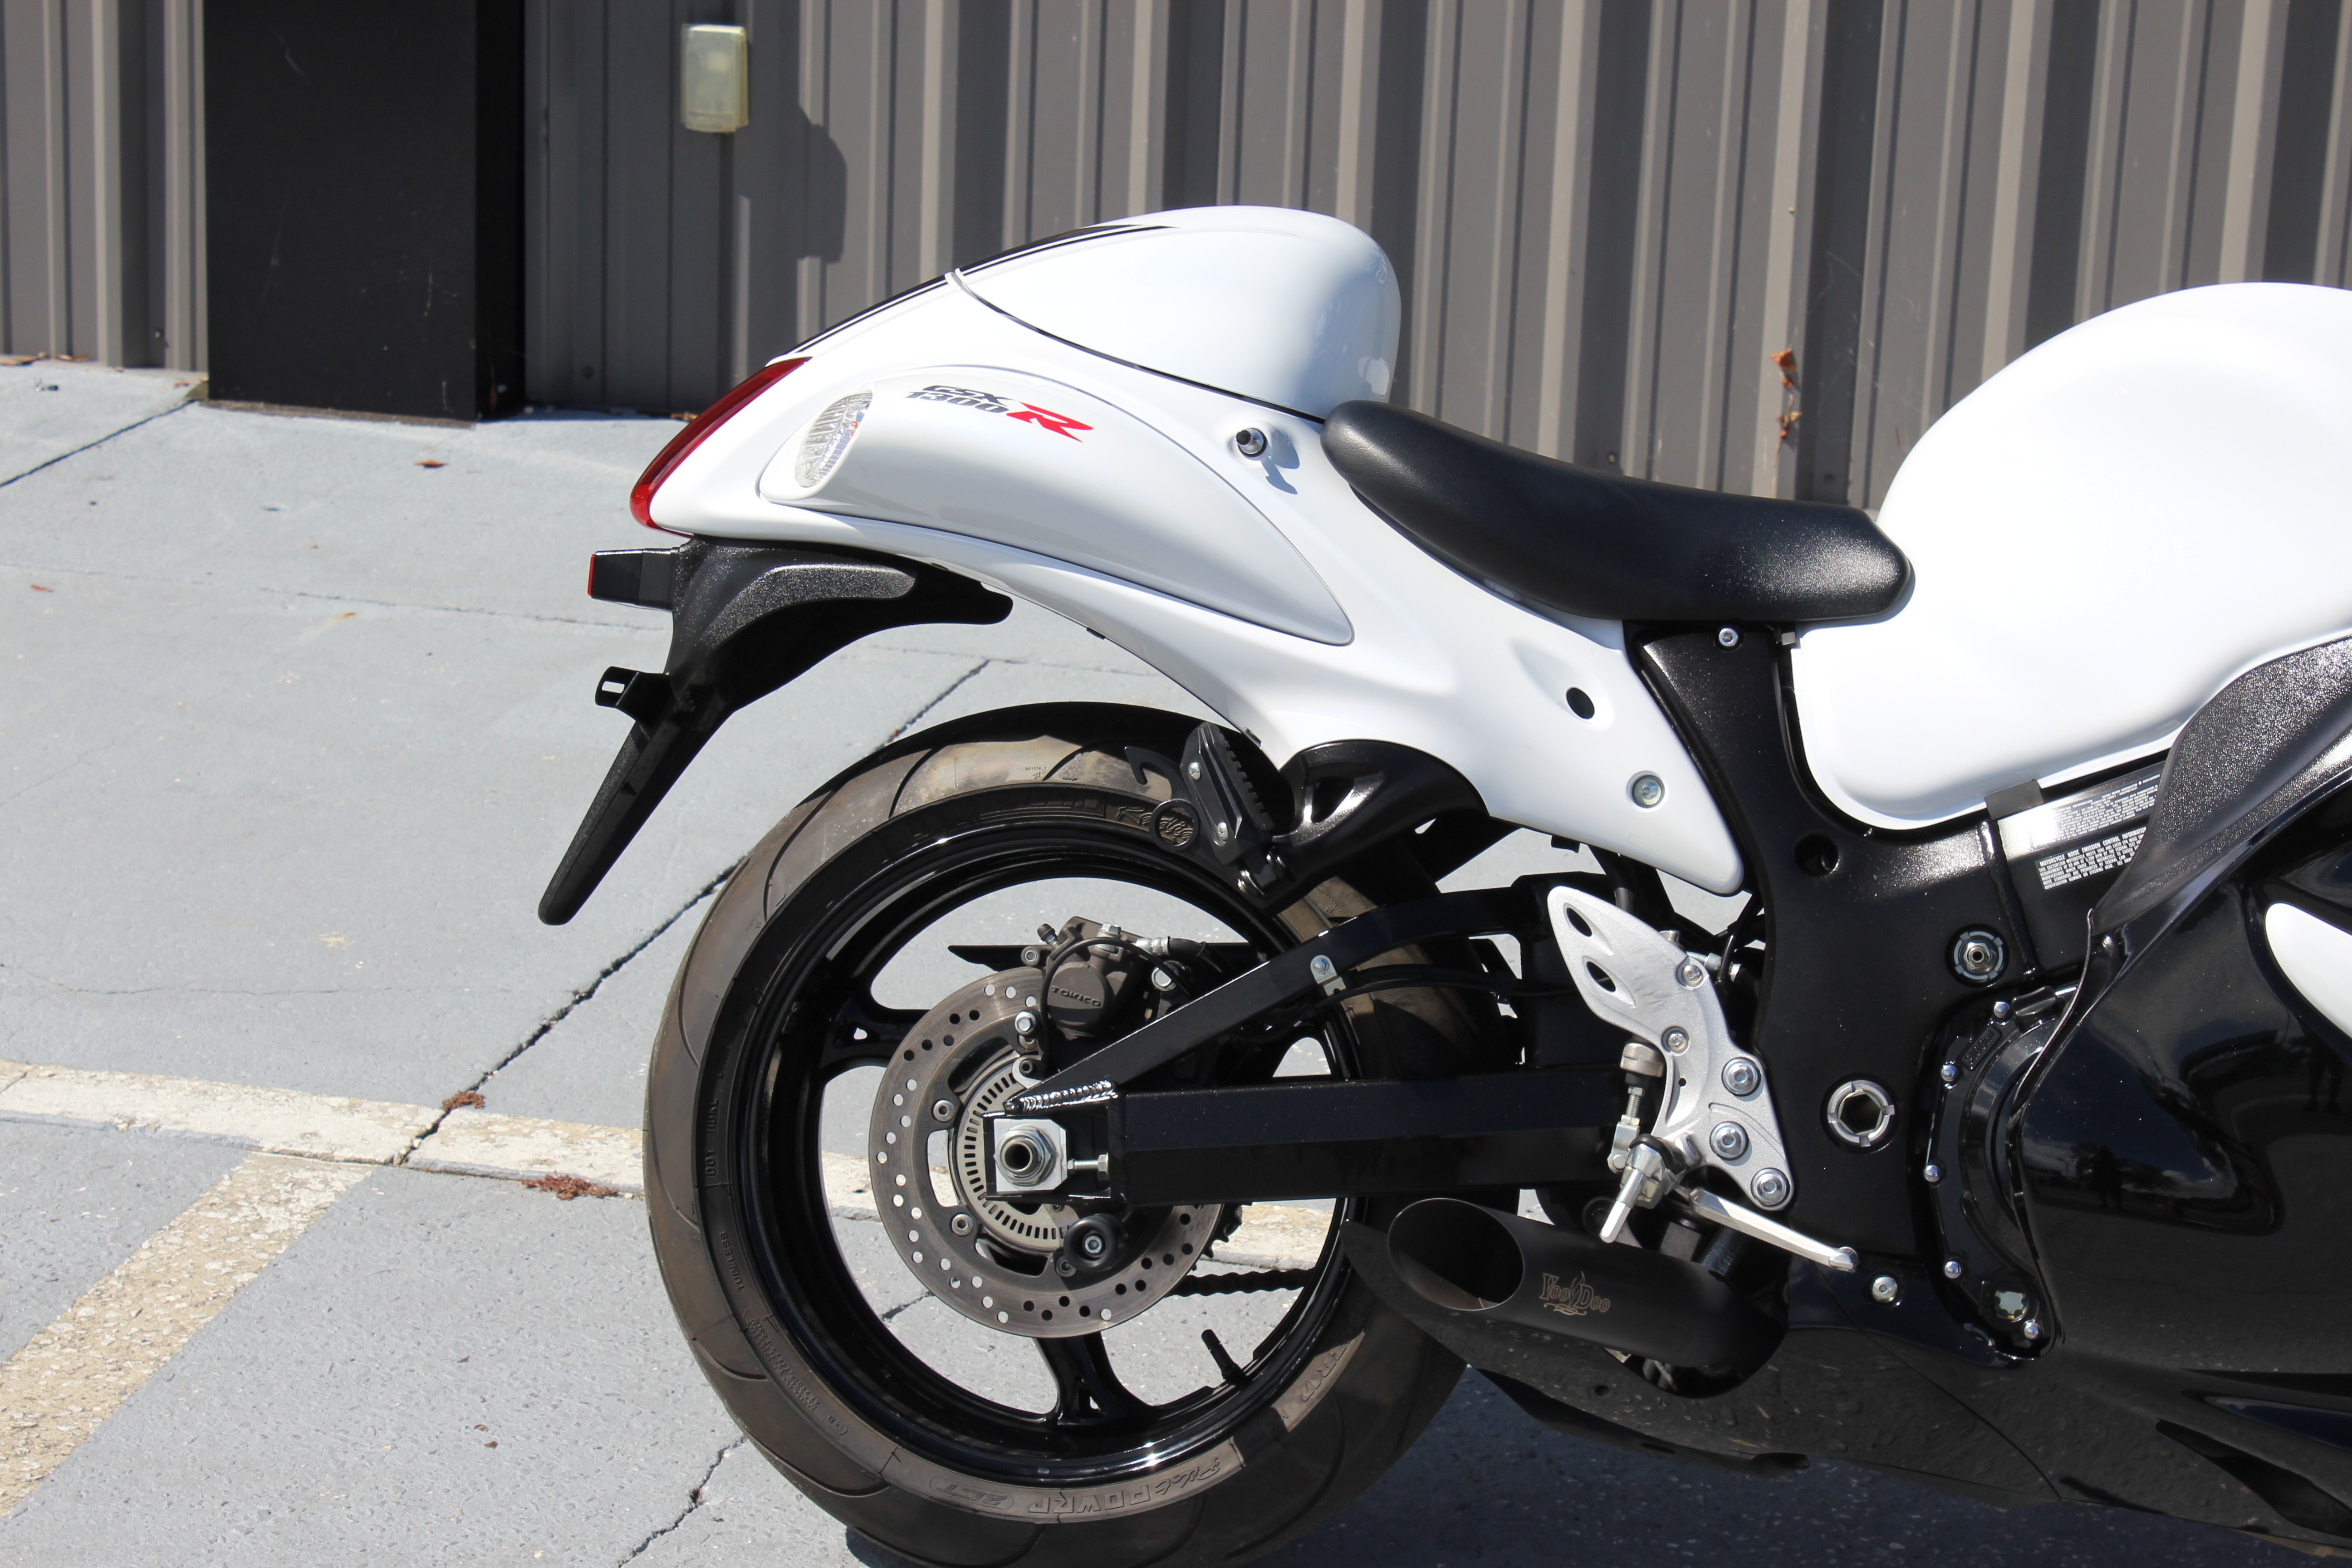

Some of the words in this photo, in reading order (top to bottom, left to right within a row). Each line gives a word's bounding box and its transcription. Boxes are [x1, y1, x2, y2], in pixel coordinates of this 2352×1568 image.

[906, 392, 1009, 413] 1300
[922, 385, 1019, 407] GSX
[1006, 401, 1094, 443] R
[2039, 853, 2066, 867] MOTORCYCLE
[2067, 848, 2080, 858] NOISE
[2081, 842, 2101, 853] EMISSION
[2102, 835, 2120, 846] CONTROL
[1052, 986, 1101, 1007] TOKICO
[719, 1231, 745, 1292] TUBELESS
